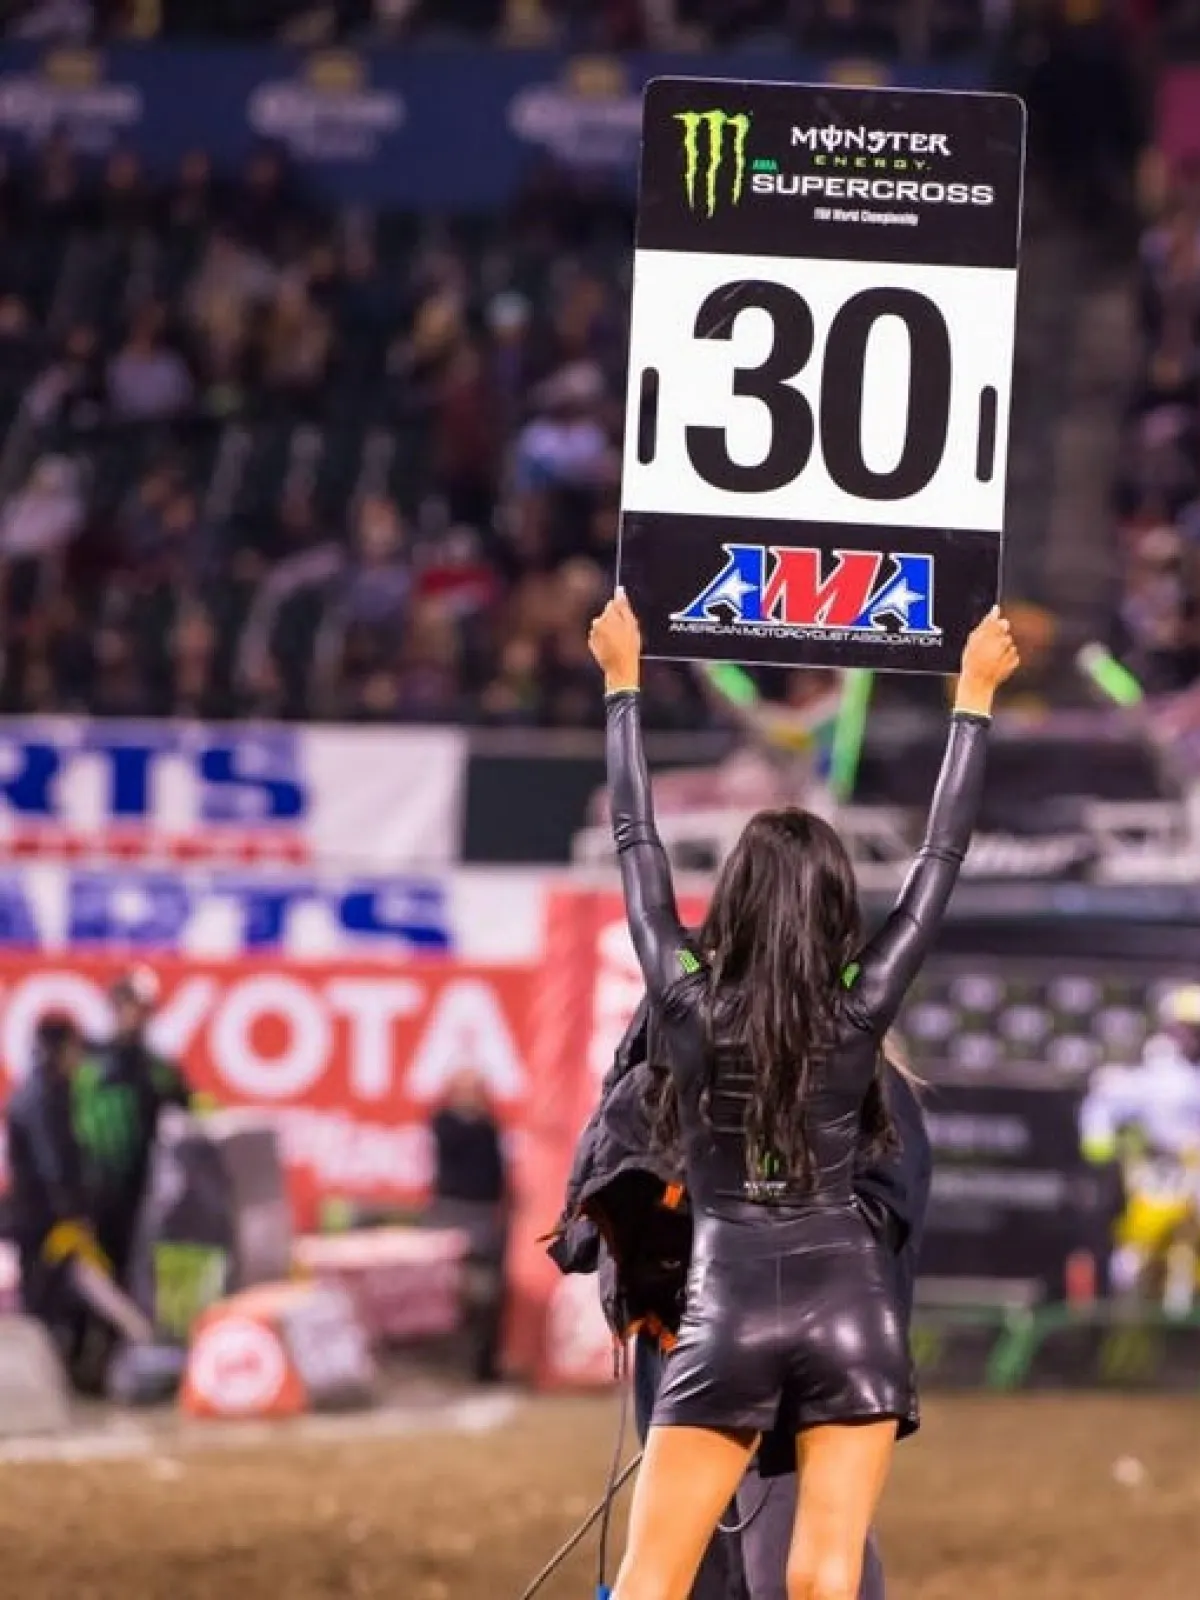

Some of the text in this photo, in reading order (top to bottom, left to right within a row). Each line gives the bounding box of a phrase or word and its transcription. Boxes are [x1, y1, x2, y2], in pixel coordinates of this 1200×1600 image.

[791, 124, 951, 156] MONSTER
[814, 154, 928, 170] ENERGY
[752, 174, 994, 205] SUPERCROSS
[685, 279, 952, 501] 30
[669, 543, 943, 634] AMA
[669, 620, 742, 635] AMERICAN
[851, 629, 943, 648] ASSOCIATION
